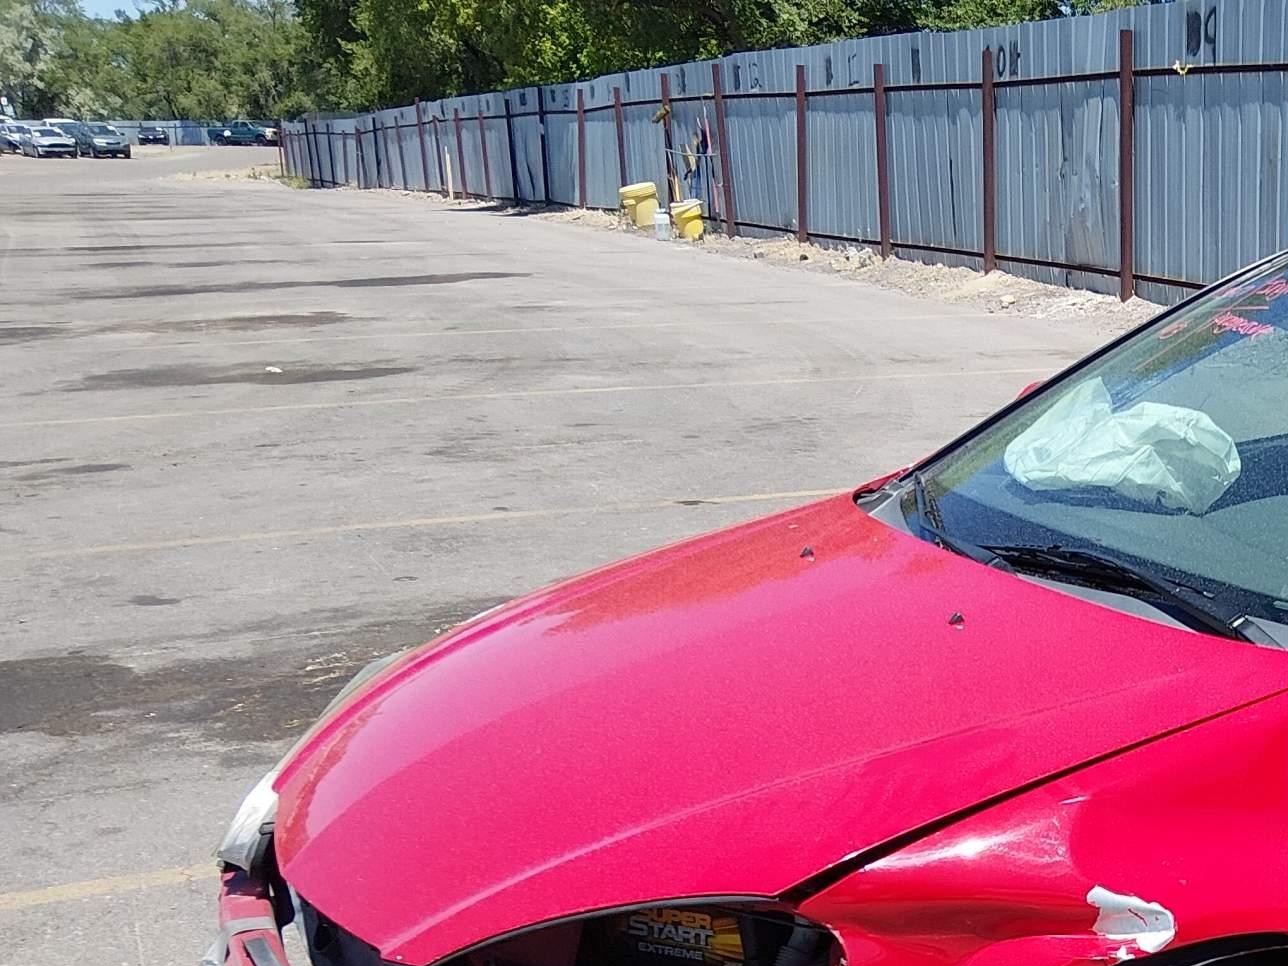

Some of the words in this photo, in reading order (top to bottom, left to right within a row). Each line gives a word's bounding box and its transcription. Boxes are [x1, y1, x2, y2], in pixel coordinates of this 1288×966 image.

[634, 908, 713, 929] SUPER
[628, 915, 714, 947] START
[637, 941, 705, 961] EXTREME
